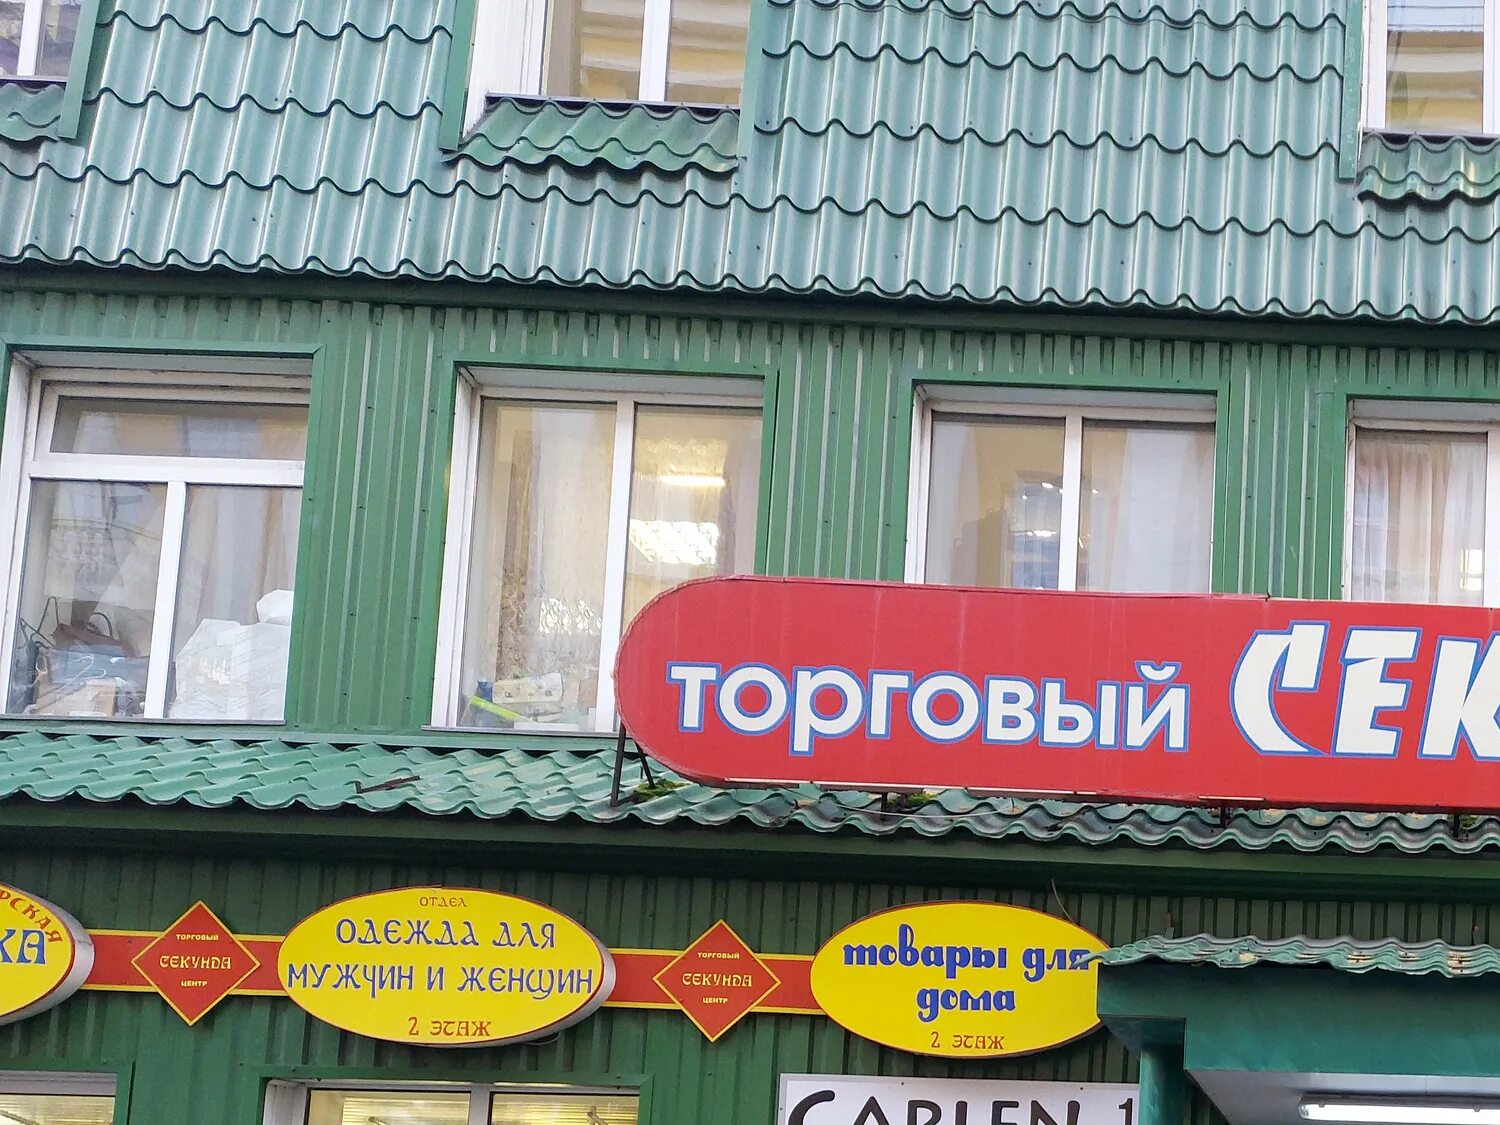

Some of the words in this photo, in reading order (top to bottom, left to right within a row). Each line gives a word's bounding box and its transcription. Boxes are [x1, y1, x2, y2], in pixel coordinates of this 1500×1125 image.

[666, 660, 1191, 756] торговый
[419, 897, 467, 908] ОТДЕЛ
[335, 919, 478, 948] ОДЕЖДА
[493, 920, 556, 948] ДЛЯ
[160, 956, 231, 969] СЕКУНДА
[697, 951, 740, 959] ТОРГОВЫЙ
[843, 923, 1007, 979] товары
[1022, 948, 1091, 983] для
[288, 964, 413, 999] МУЖЧИН
[427, 967, 444, 991] И
[457, 966, 593, 1001] ЖЕНЩИН
[682, 972, 753, 988] СЕКУНДА
[702, 996, 728, 1004] ЦЕНТР
[916, 988, 1016, 1022] дома
[408, 1017, 420, 1036] 2
[431, 1020, 492, 1038] ЭТАЖ
[930, 1031, 941, 1049] 2
[952, 1035, 1005, 1050] ЭТАЖ
